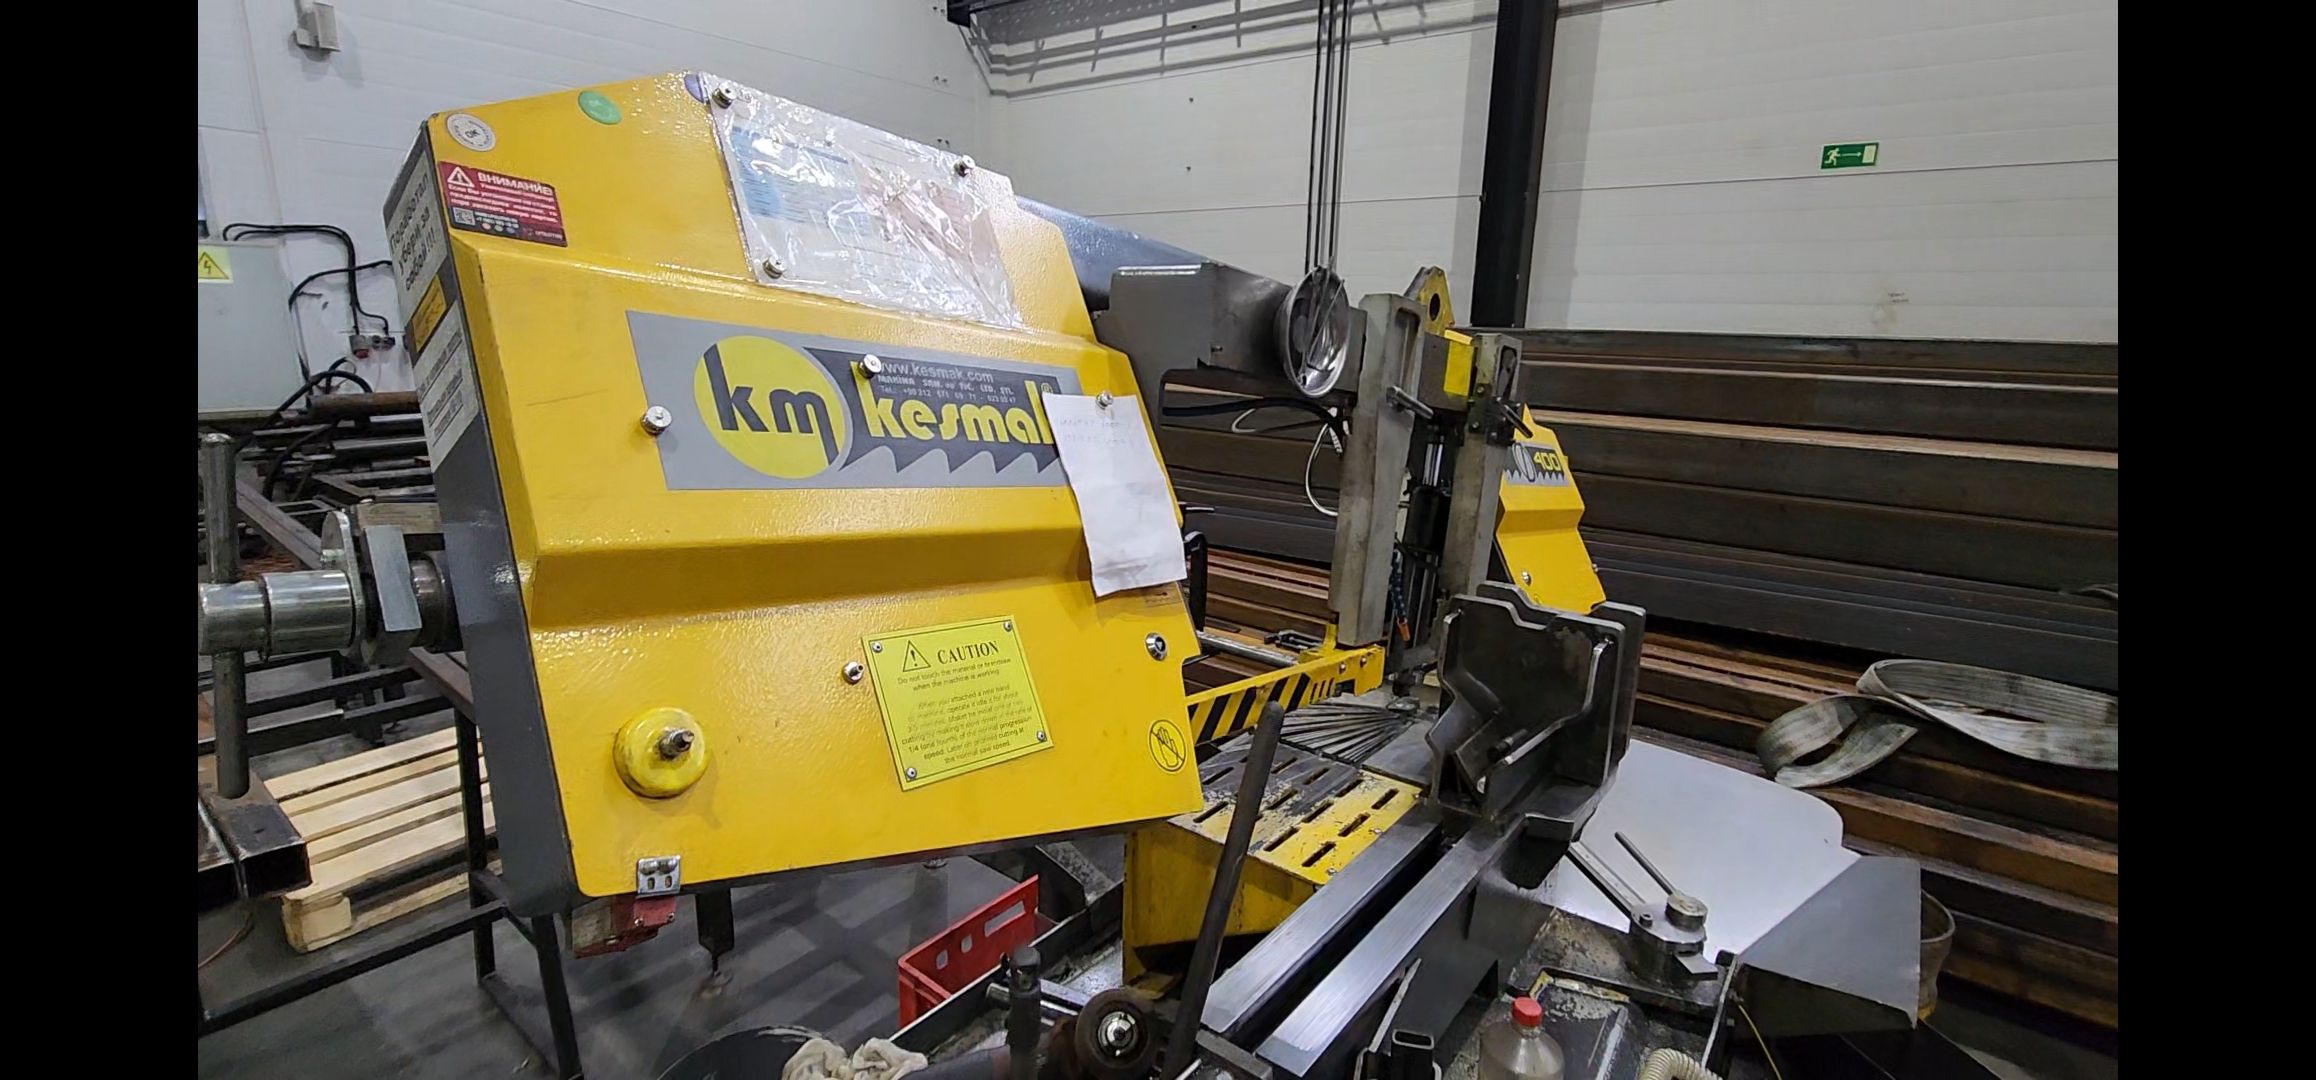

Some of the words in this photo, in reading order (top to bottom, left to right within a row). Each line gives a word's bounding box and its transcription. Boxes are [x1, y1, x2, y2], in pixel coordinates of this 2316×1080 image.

[703, 343, 840, 466] km
[1533, 451, 1562, 471] 400
[937, 641, 999, 665] CAUTION
